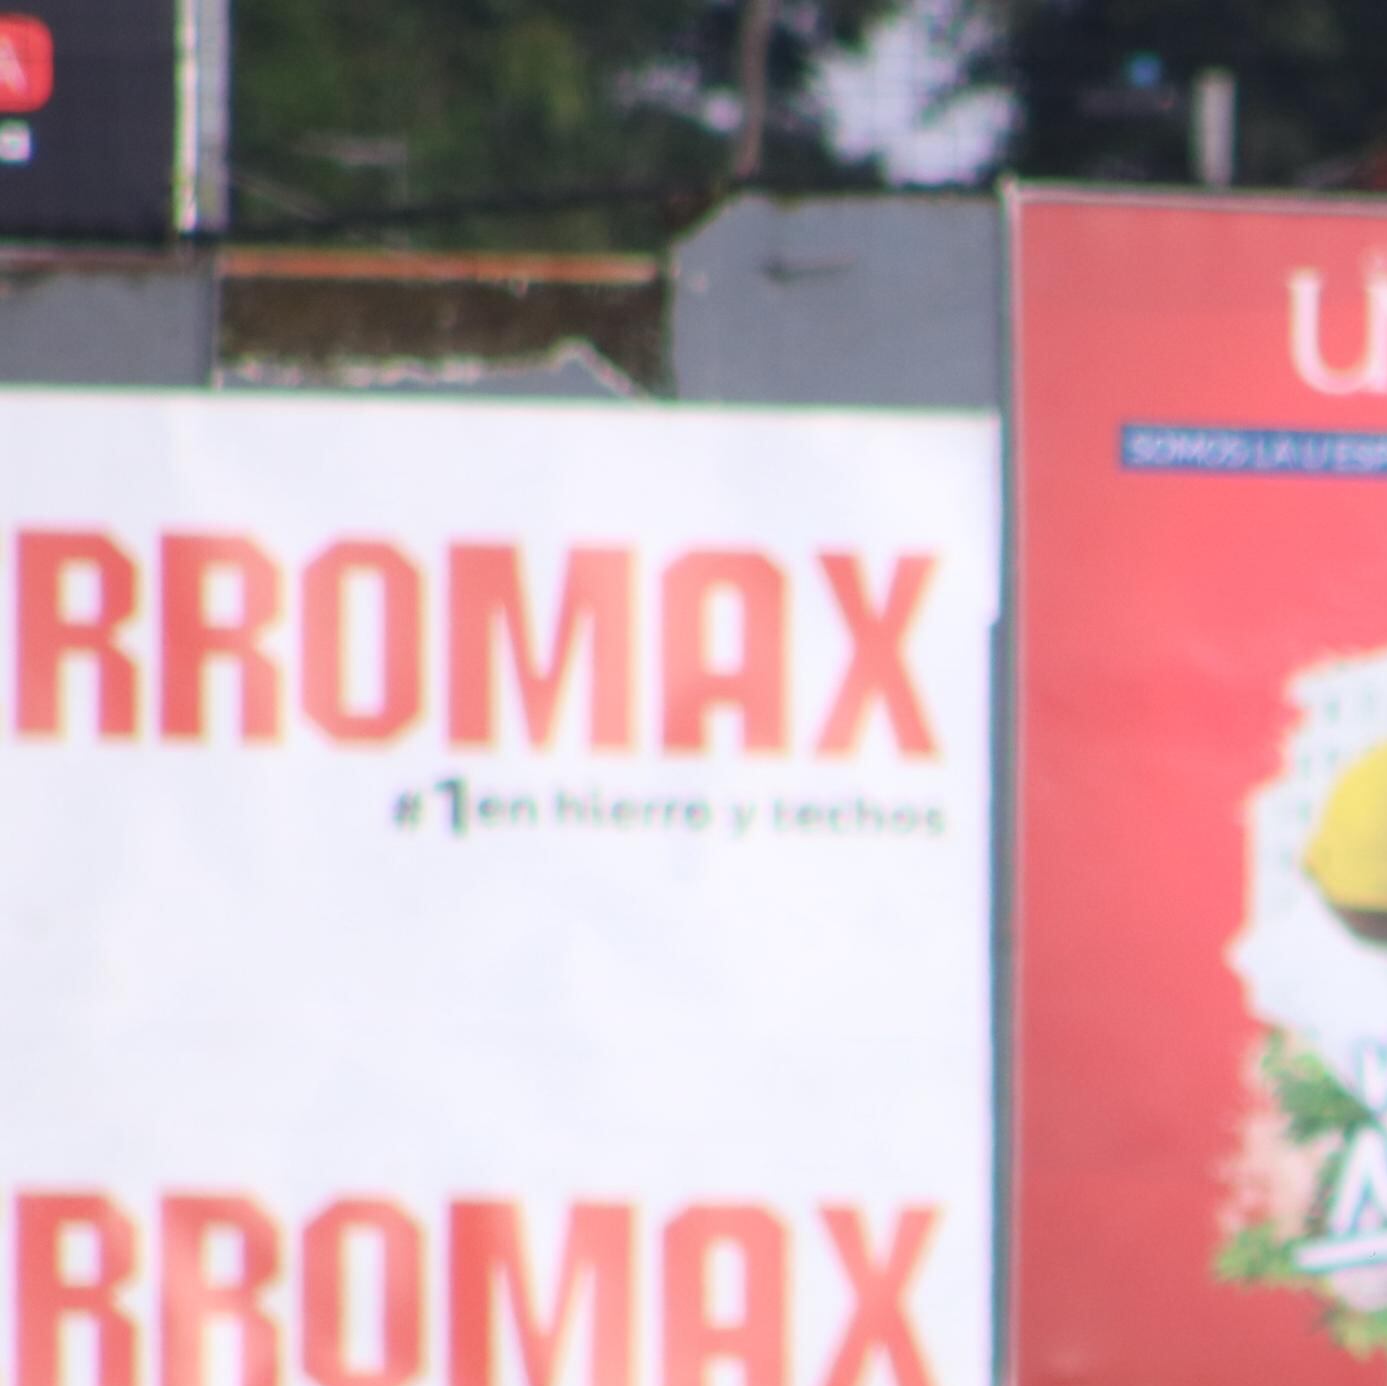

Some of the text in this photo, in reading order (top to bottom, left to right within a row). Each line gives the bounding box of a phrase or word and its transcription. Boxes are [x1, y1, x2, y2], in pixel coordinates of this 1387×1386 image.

[13, 528, 942, 762] RROMAX
[555, 787, 714, 834] hierro
[731, 799, 758, 840] y
[772, 796, 949, 838] techos
